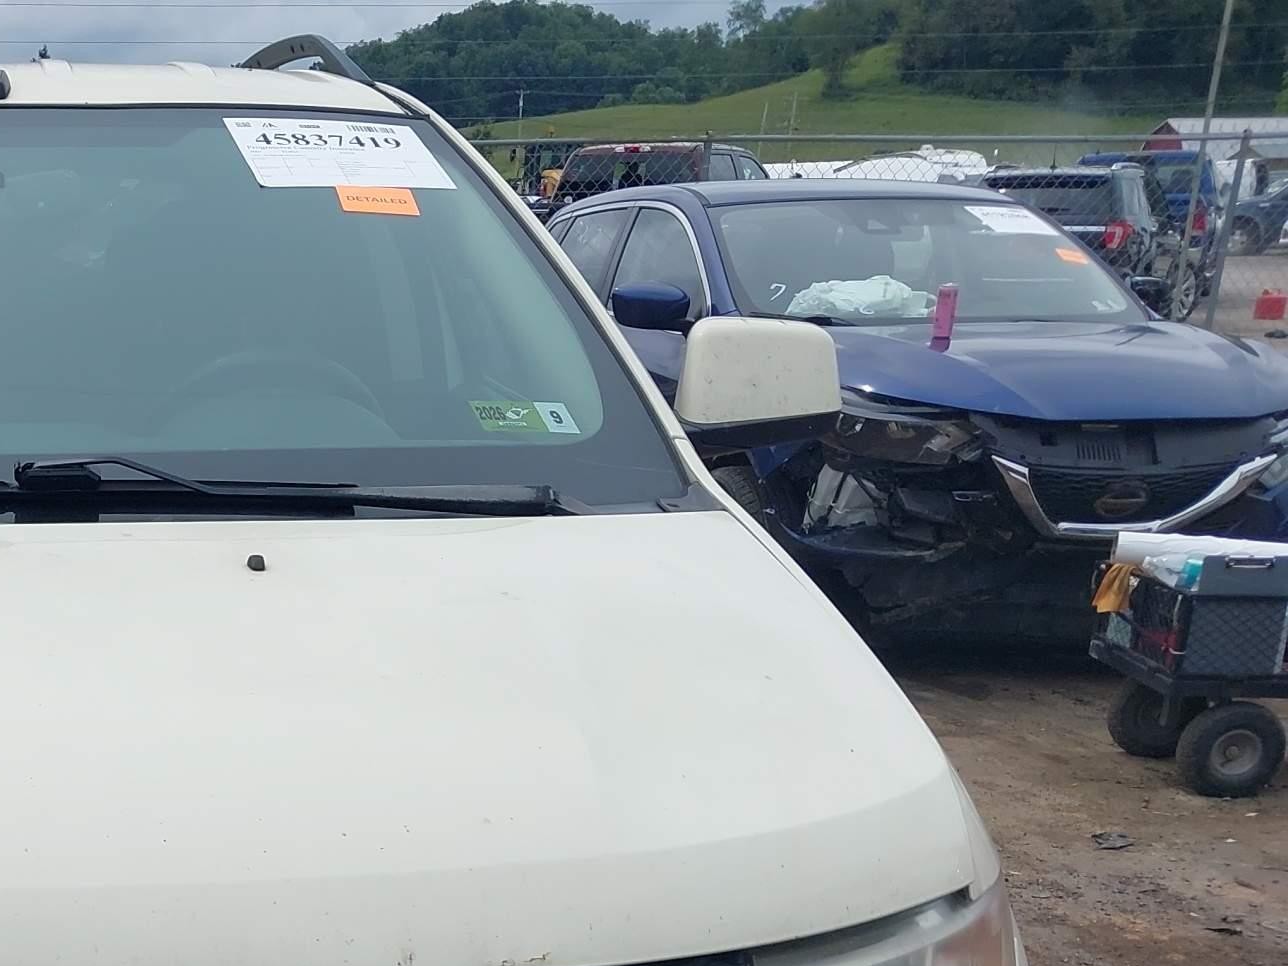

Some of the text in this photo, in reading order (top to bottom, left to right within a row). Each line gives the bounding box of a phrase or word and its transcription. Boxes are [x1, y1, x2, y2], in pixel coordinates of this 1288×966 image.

[255, 132, 402, 149] 45837419
[345, 195, 408, 205] DETAILED
[475, 406, 507, 421] 2026
[549, 410, 564, 425] 9
